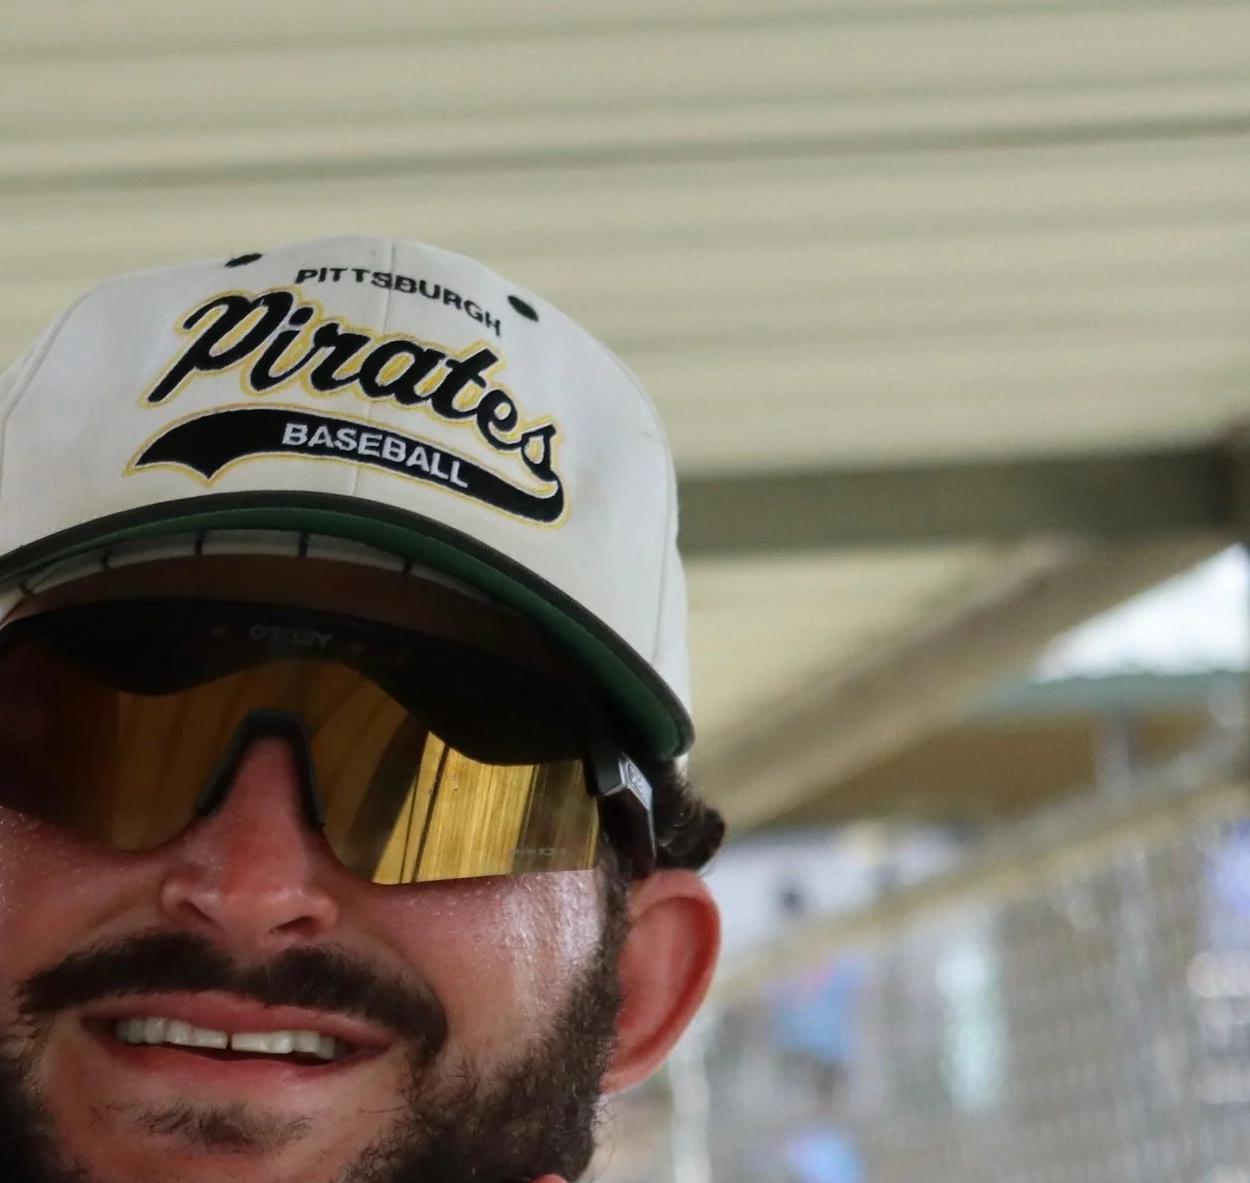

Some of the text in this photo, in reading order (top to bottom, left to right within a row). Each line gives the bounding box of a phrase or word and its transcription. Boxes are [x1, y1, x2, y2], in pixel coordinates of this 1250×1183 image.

[294, 266, 502, 338] PITTSBURGH
[141, 287, 562, 488] Pirates
[281, 421, 470, 490] BASEBALL
